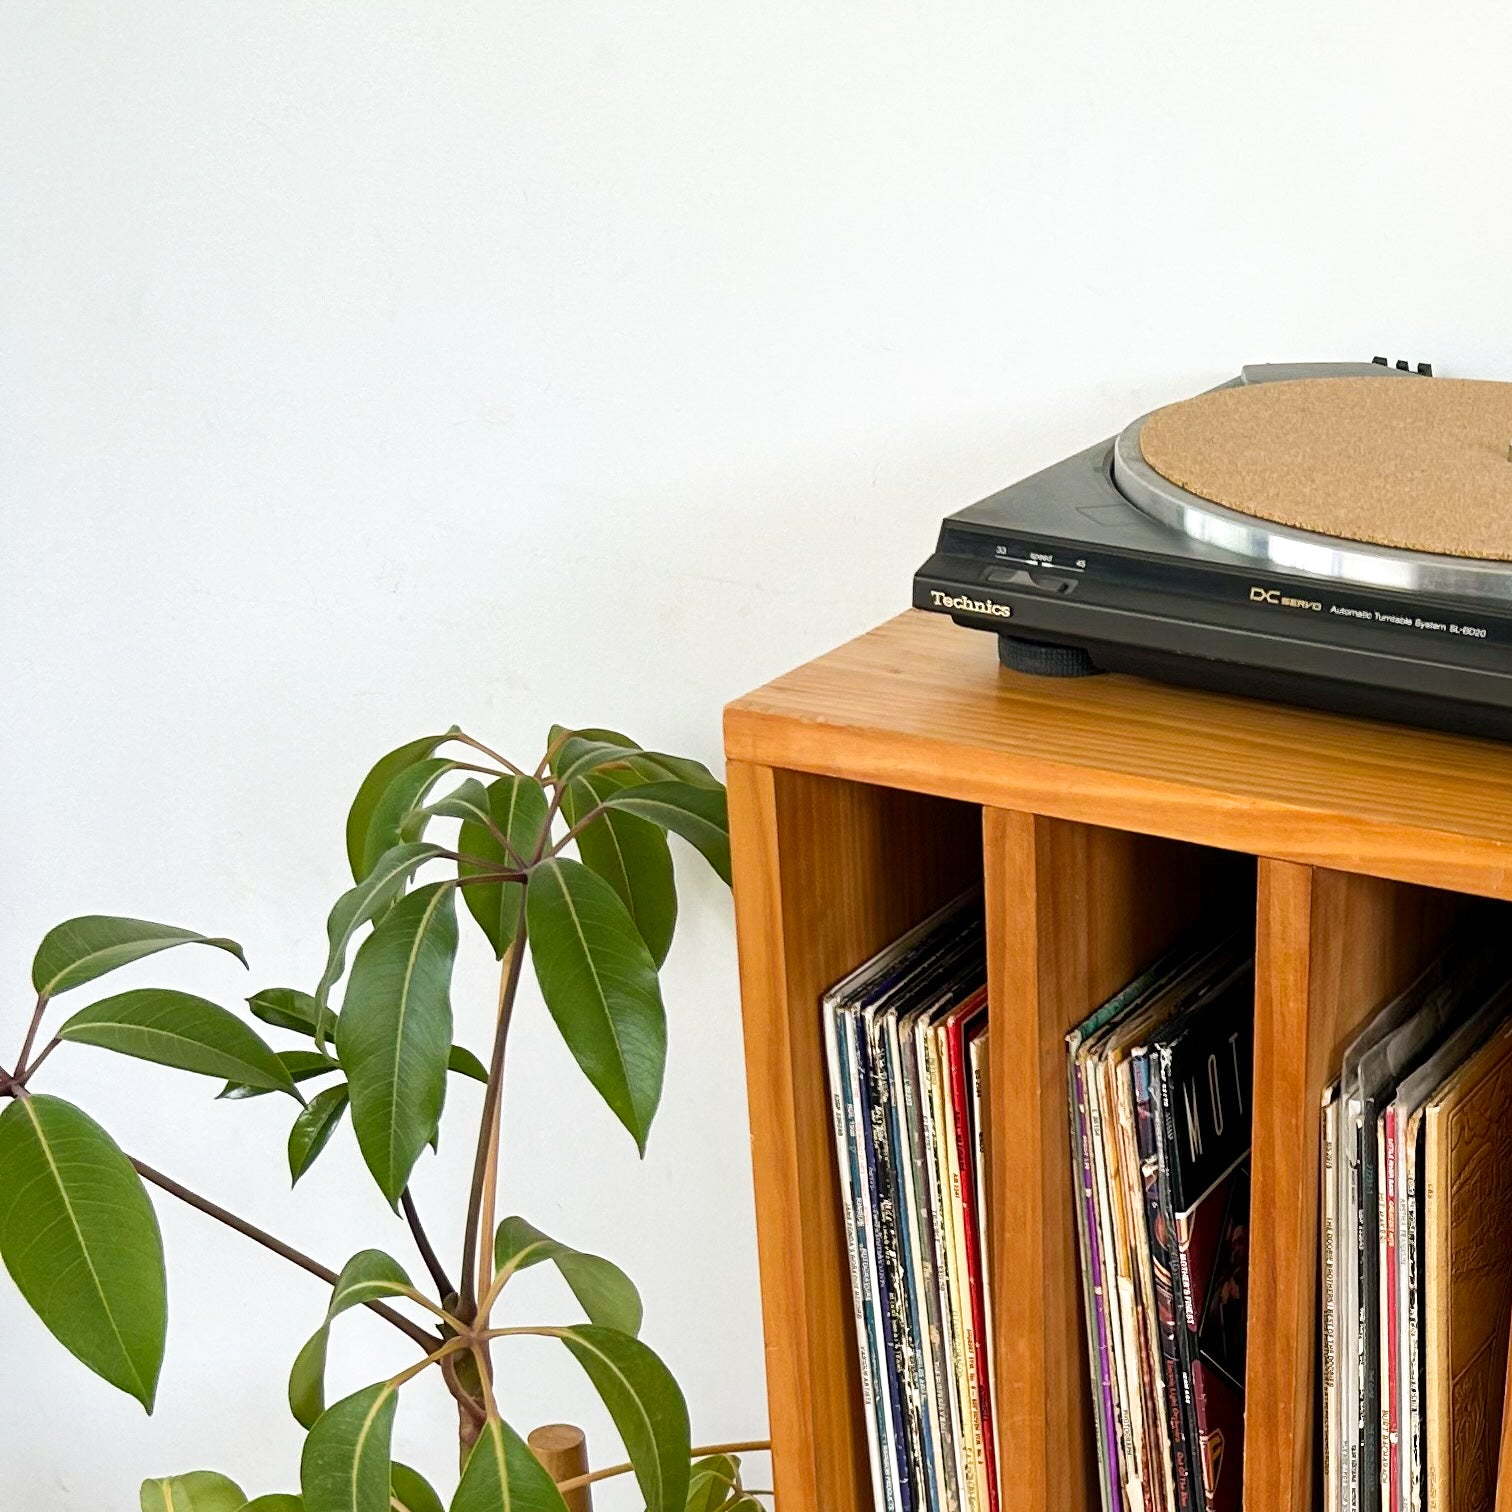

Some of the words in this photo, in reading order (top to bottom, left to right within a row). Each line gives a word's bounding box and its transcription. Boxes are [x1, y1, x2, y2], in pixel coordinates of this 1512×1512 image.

[1030, 553, 1053, 561] speed
[1076, 560, 1086, 568] 45
[930, 591, 1011, 617] Technics
[1250, 587, 1280, 603] DC
[1281, 597, 1322, 611] SERVO
[1330, 606, 1372, 620] Automatic
[1375, 613, 1412, 626] Turntable
[1415, 619, 1446, 631] System
[1179, 1253, 1191, 1294] MOTHER'S
[1120, 1409, 1131, 1455] PHOTOGRAPH
